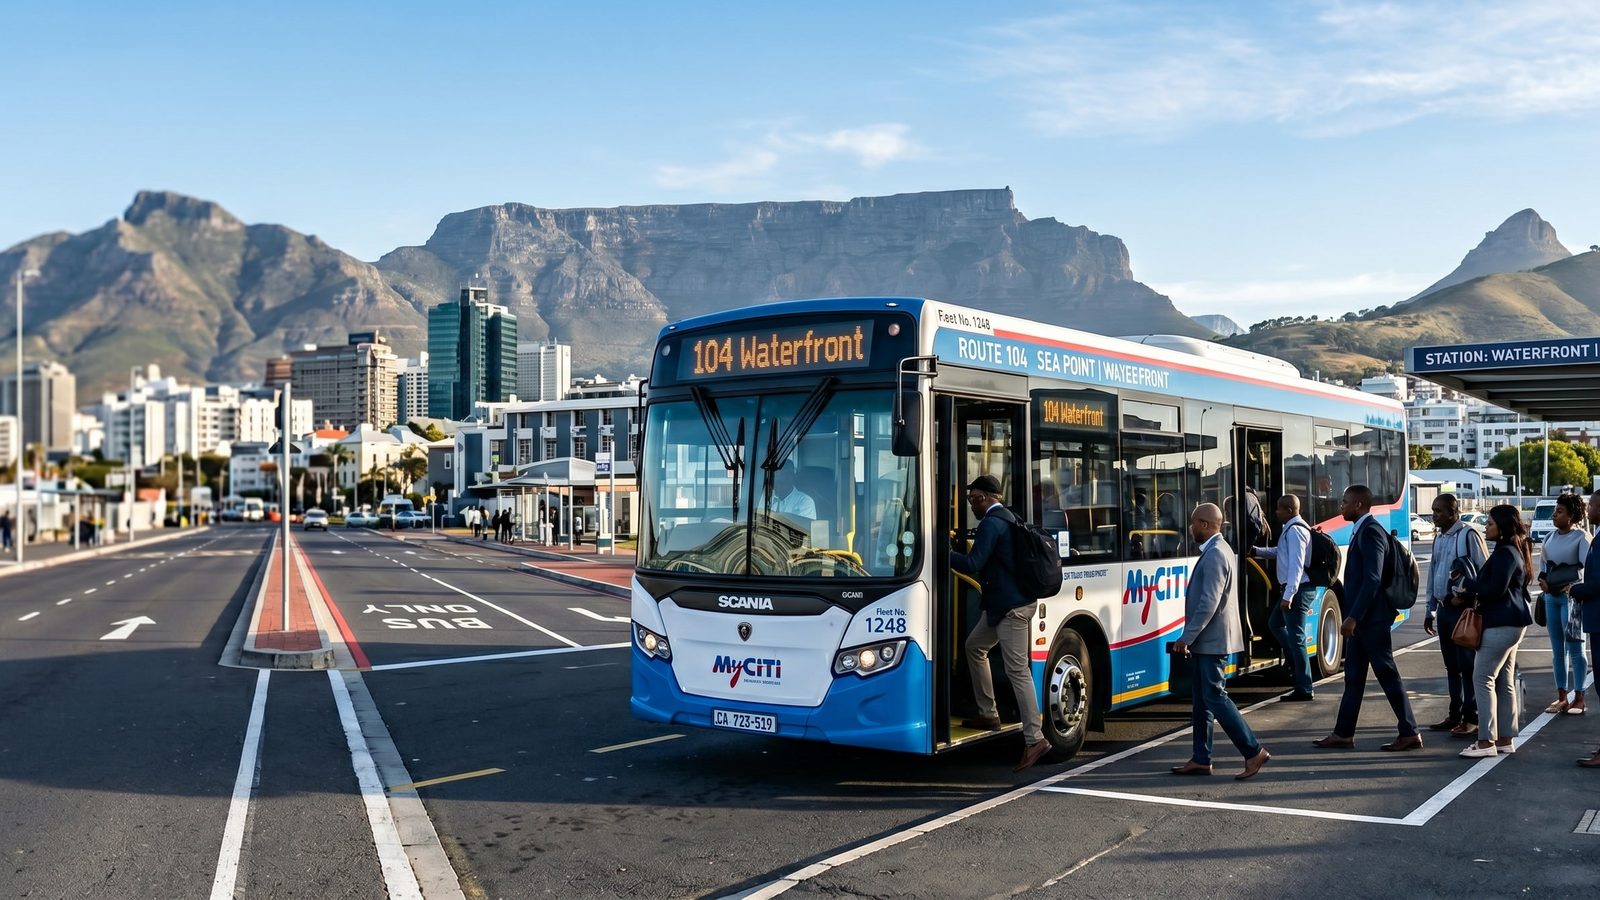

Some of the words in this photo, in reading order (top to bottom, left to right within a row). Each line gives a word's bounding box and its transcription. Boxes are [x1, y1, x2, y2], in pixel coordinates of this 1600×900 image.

[958, 314, 971, 327] No.
[972, 317, 990, 330] 1248
[694, 337, 733, 374] 104
[740, 325, 864, 370] Waterfront
[958, 337, 1002, 364] ROUTE
[1006, 345, 1028, 368] 104
[1037, 350, 1060, 373] SEA
[1063, 355, 1095, 378] POINT
[1425, 350, 1488, 366] STATION:
[1491, 344, 1590, 361] WATERFRONT
[1060, 402, 1104, 427] Waterfront
[362, 604, 478, 614] ONLY
[718, 595, 774, 610] SCANIA
[876, 608, 893, 616] Fleet
[894, 608, 907, 616] No.
[381, 617, 493, 629] BUS
[865, 617, 907, 633] 1248
[733, 714, 773, 731] 723-519
